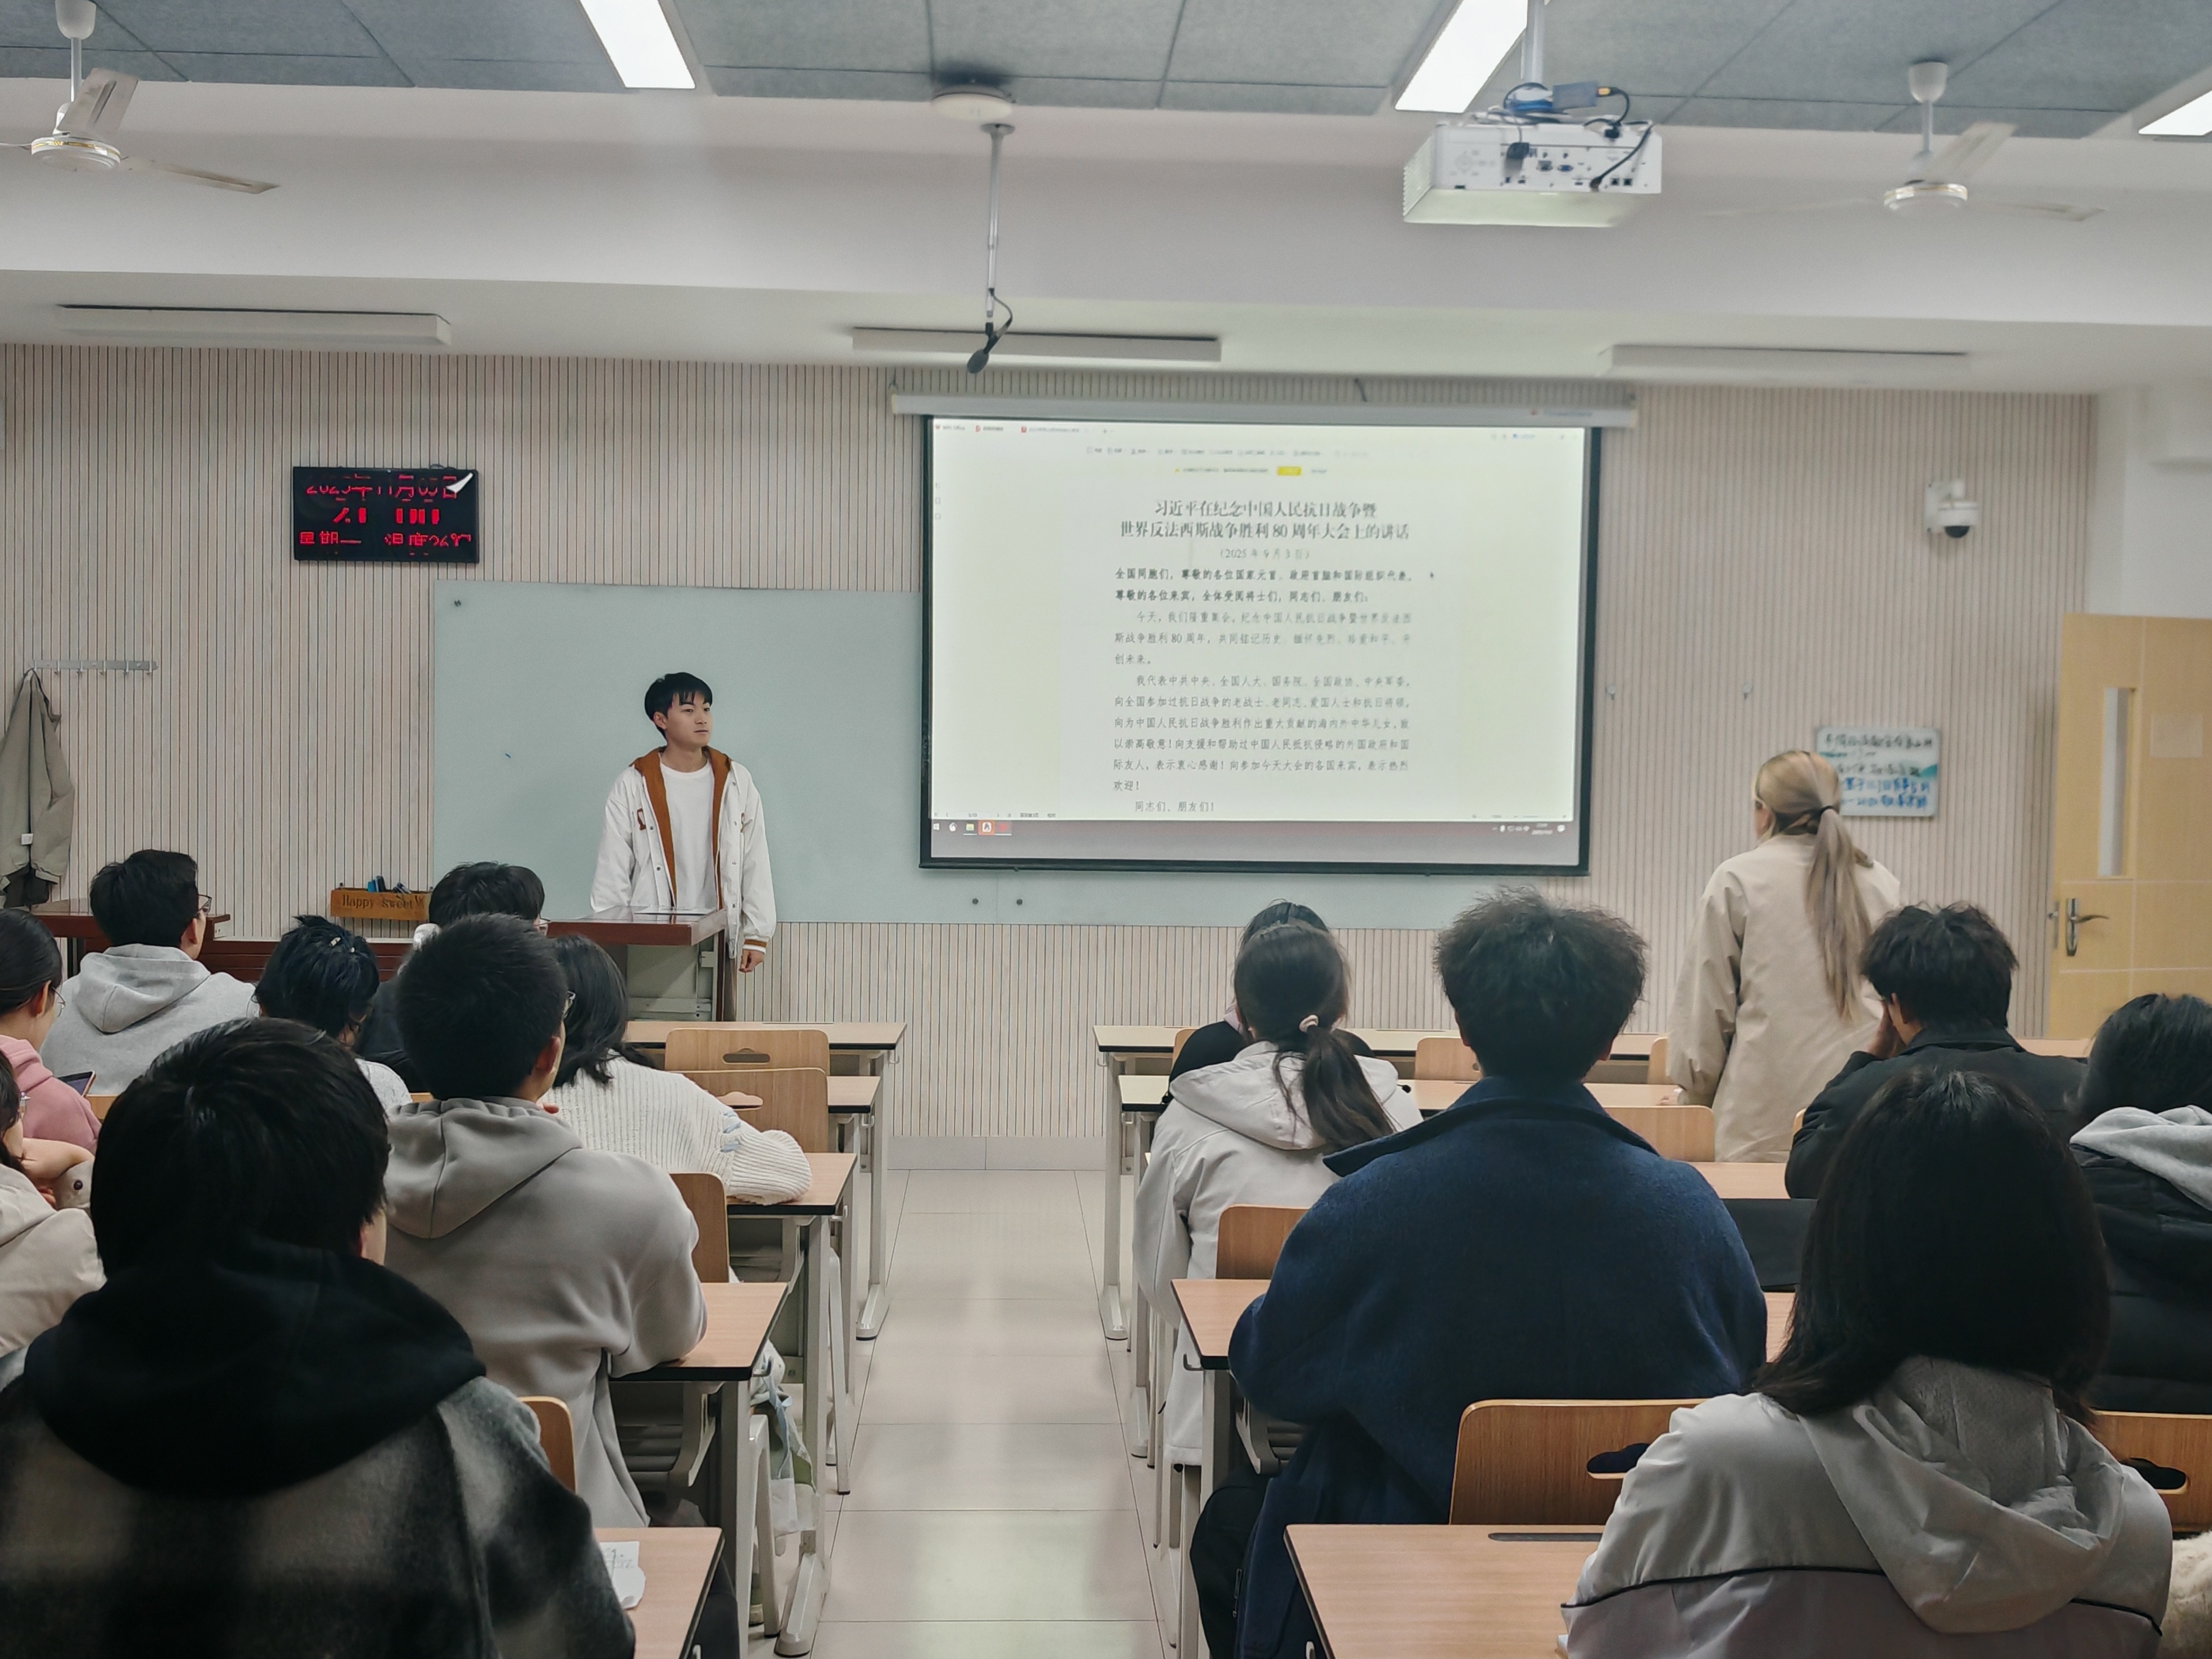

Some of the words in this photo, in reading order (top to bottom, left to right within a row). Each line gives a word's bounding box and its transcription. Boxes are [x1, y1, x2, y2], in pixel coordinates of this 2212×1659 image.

[1155, 500, 1376, 517] 习近平在纪念中国人民抗日战争暨
[1115, 653, 1151, 664] 创未来。
[1114, 780, 1139, 791] 欢迎！
[342, 894, 375, 909] Happy
